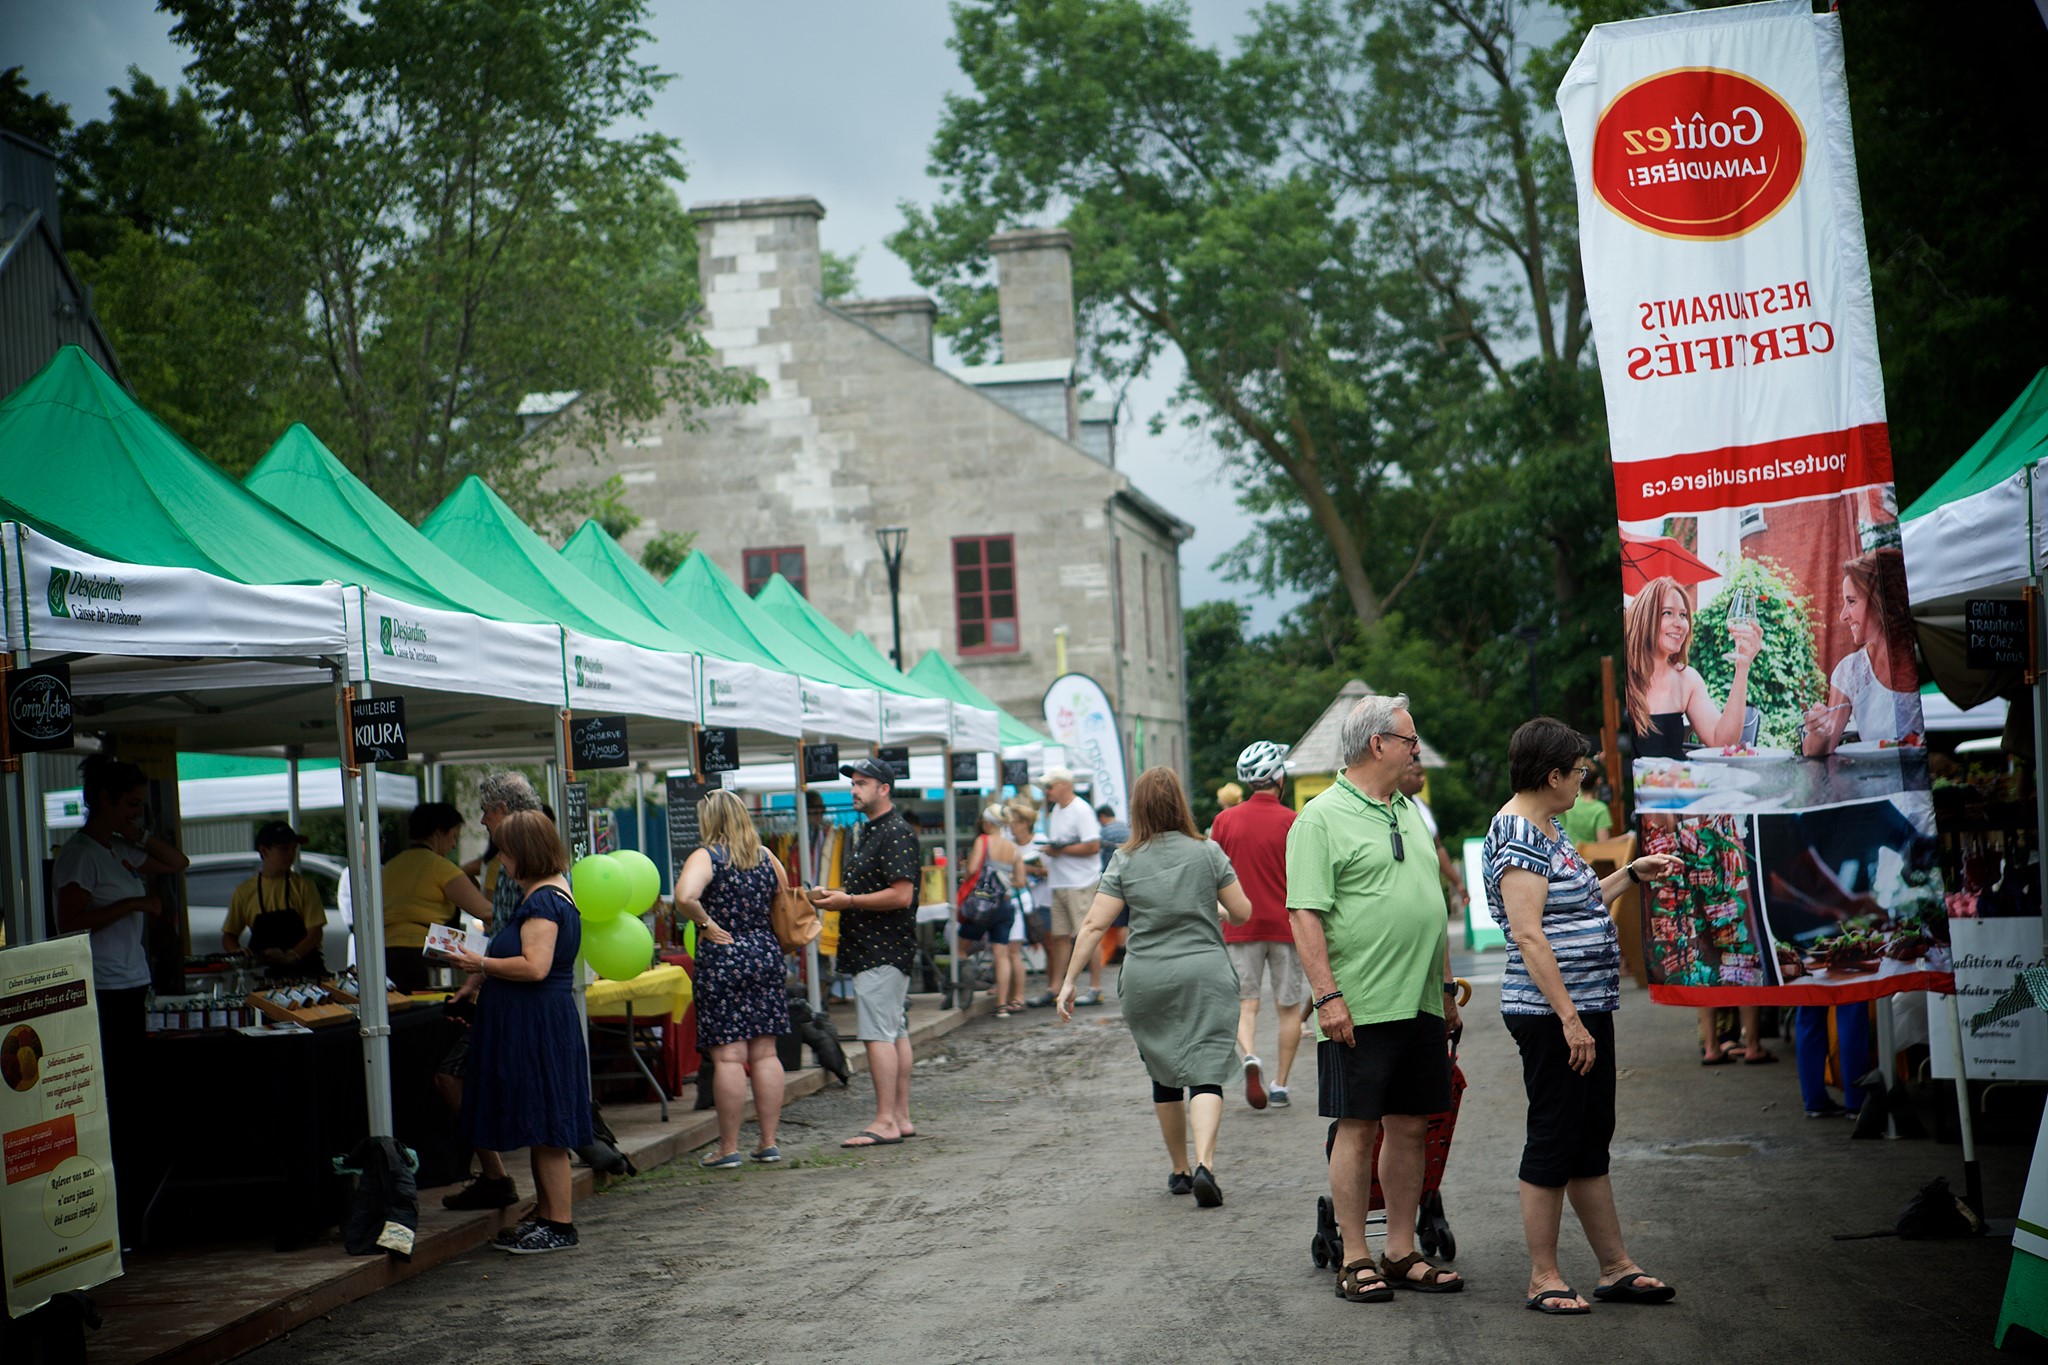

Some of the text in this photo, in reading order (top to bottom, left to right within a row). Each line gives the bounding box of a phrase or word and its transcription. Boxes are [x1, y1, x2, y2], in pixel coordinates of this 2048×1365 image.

[68, 571, 124, 605] Desjardins
[72, 604, 142, 626] Caisse de Terrebonne
[1968, 619, 2025, 632] TRADITIONS
[394, 618, 427, 644] Desjardins
[353, 700, 396, 716] HUILERIE
[355, 722, 404, 747] KOURA
[1953, 954, 2003, 969] adition
[0, 1002, 22, 1018] omposés
[44, 994, 58, 1010] fines
[58, 994, 64, 1002] et
[50, 1167, 95, 1190] Relever vos mets
[76, 1186, 94, 1204] jamais
[54, 1202, 98, 1228] été aussi simple!
